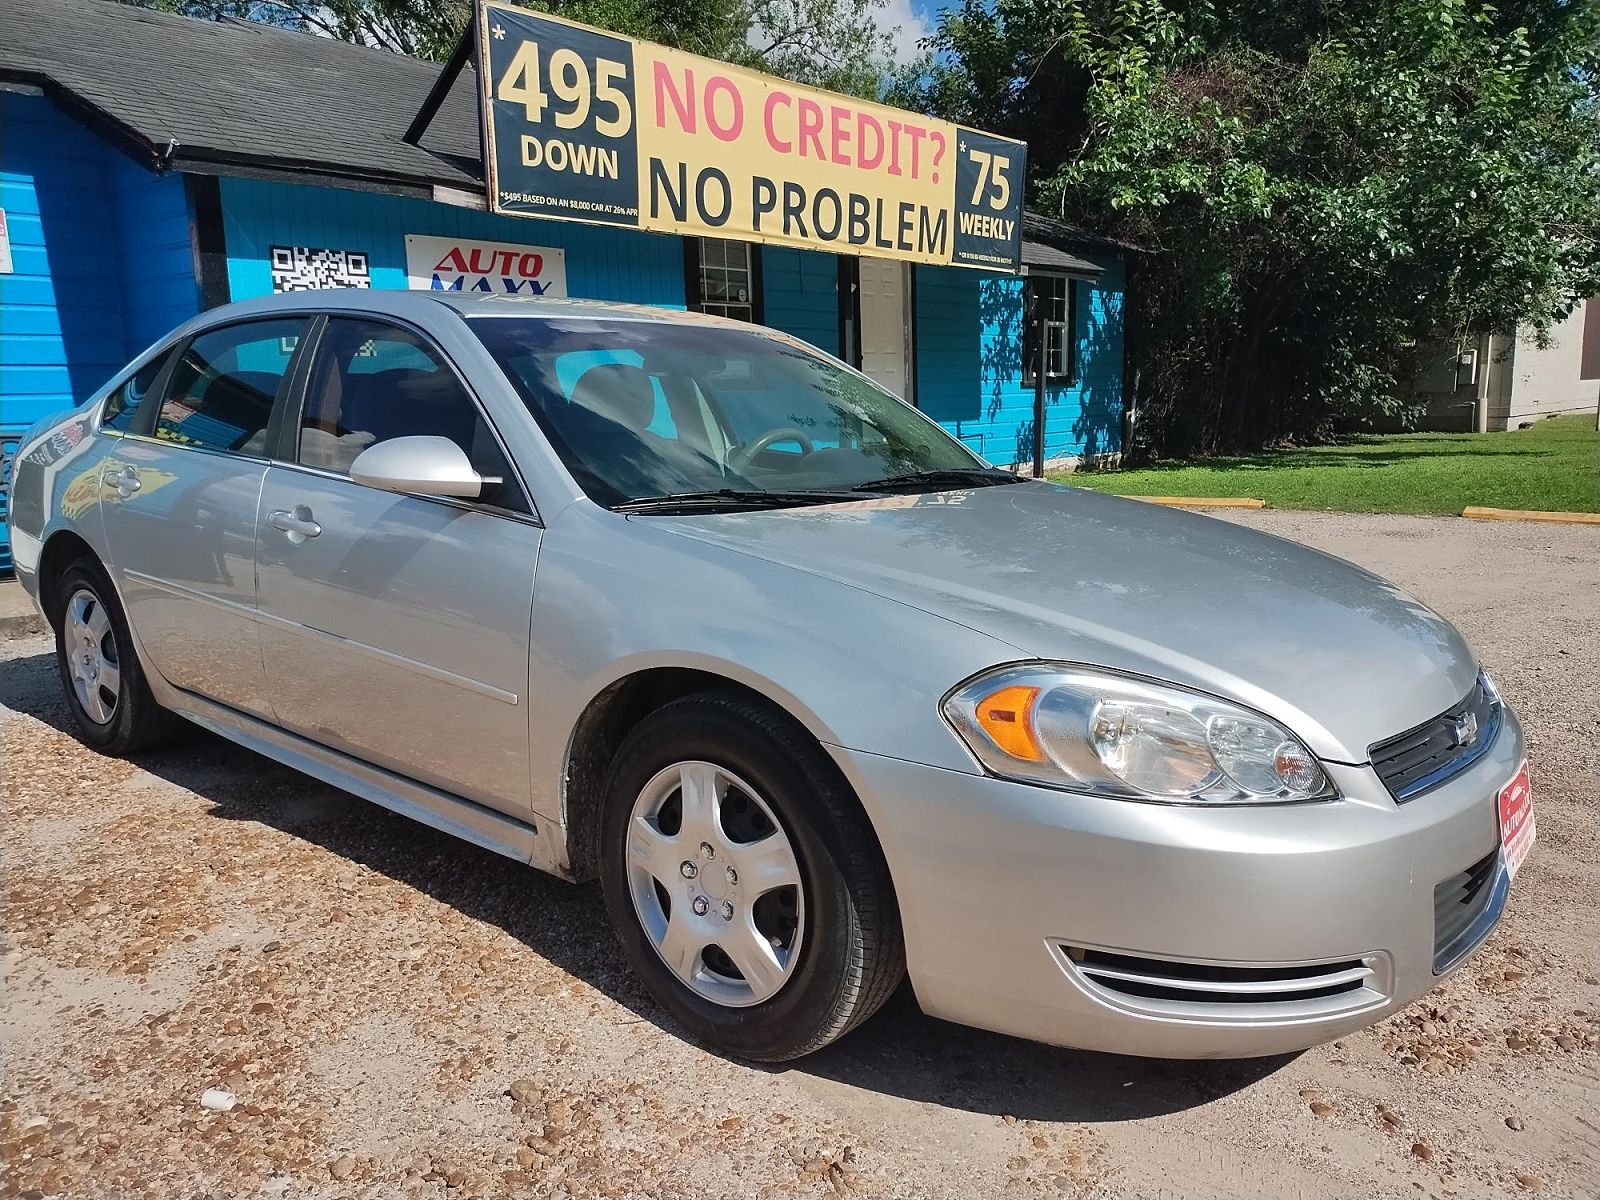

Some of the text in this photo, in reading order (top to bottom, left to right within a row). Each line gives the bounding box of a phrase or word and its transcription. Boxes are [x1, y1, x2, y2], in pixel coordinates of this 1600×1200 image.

[653, 60, 946, 184] NO CREDIT?
[520, 134, 619, 180] DOWN
[522, 194, 545, 205] BASED
[546, 197, 558, 206] ON
[558, 198, 569, 208] AN
[569, 200, 591, 210] $8,000
[591, 203, 605, 212] CAR
[604, 204, 613, 213] AT
[626, 207, 638, 217] APR
[650, 156, 948, 255] NO PROBLEM
[959, 212, 1014, 241] WEEKLY
[433, 247, 544, 278] AUTO
